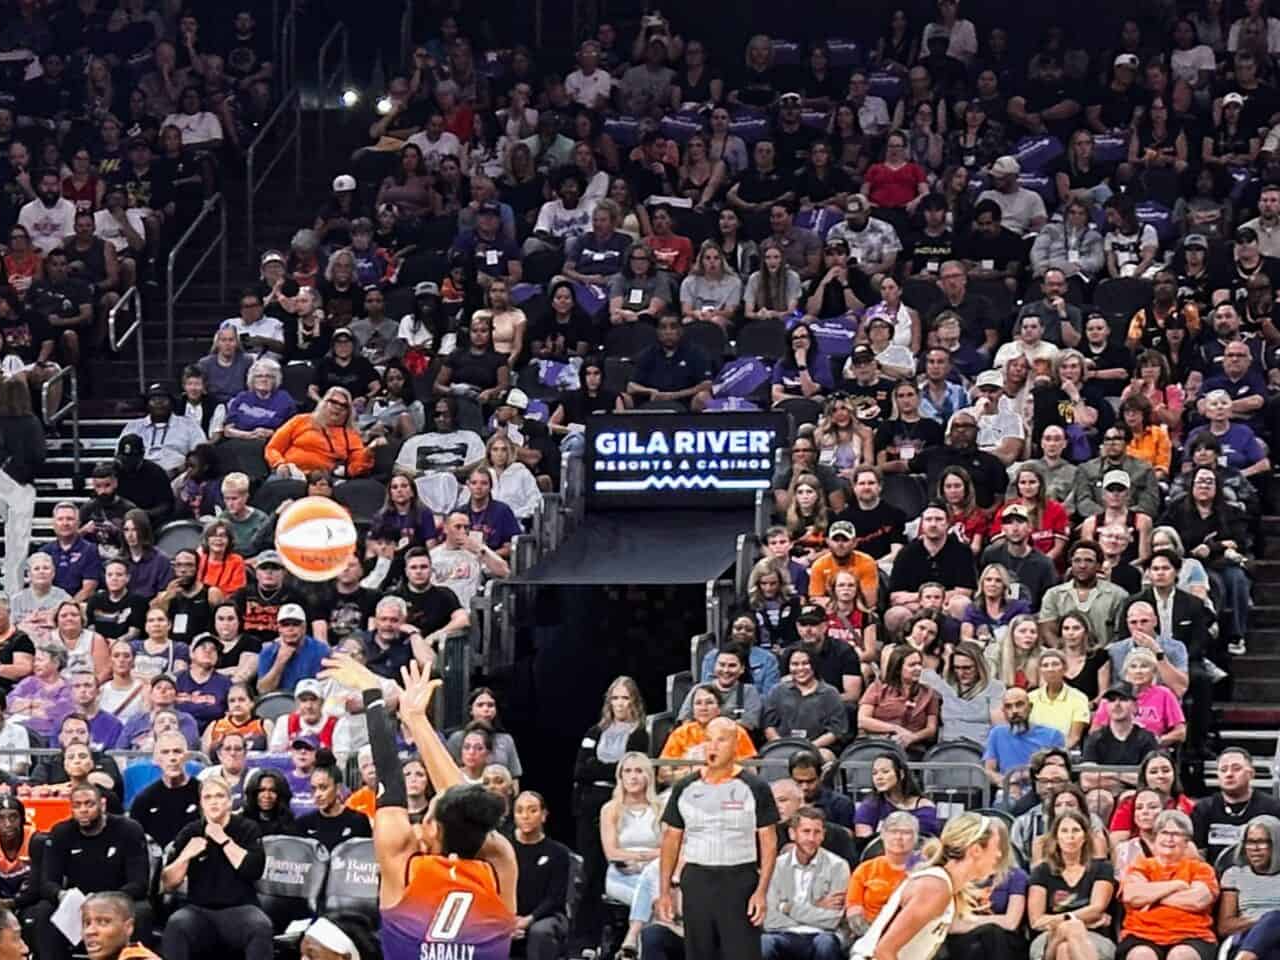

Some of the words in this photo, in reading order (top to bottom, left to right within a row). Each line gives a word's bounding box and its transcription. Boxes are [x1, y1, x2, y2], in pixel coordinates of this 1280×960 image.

[595, 432, 669, 455] GILA
[674, 431, 770, 454] RIVER
[595, 460, 672, 471] RESORTS
[696, 459, 771, 470] CASINOS
[426, 890, 473, 941] 0
